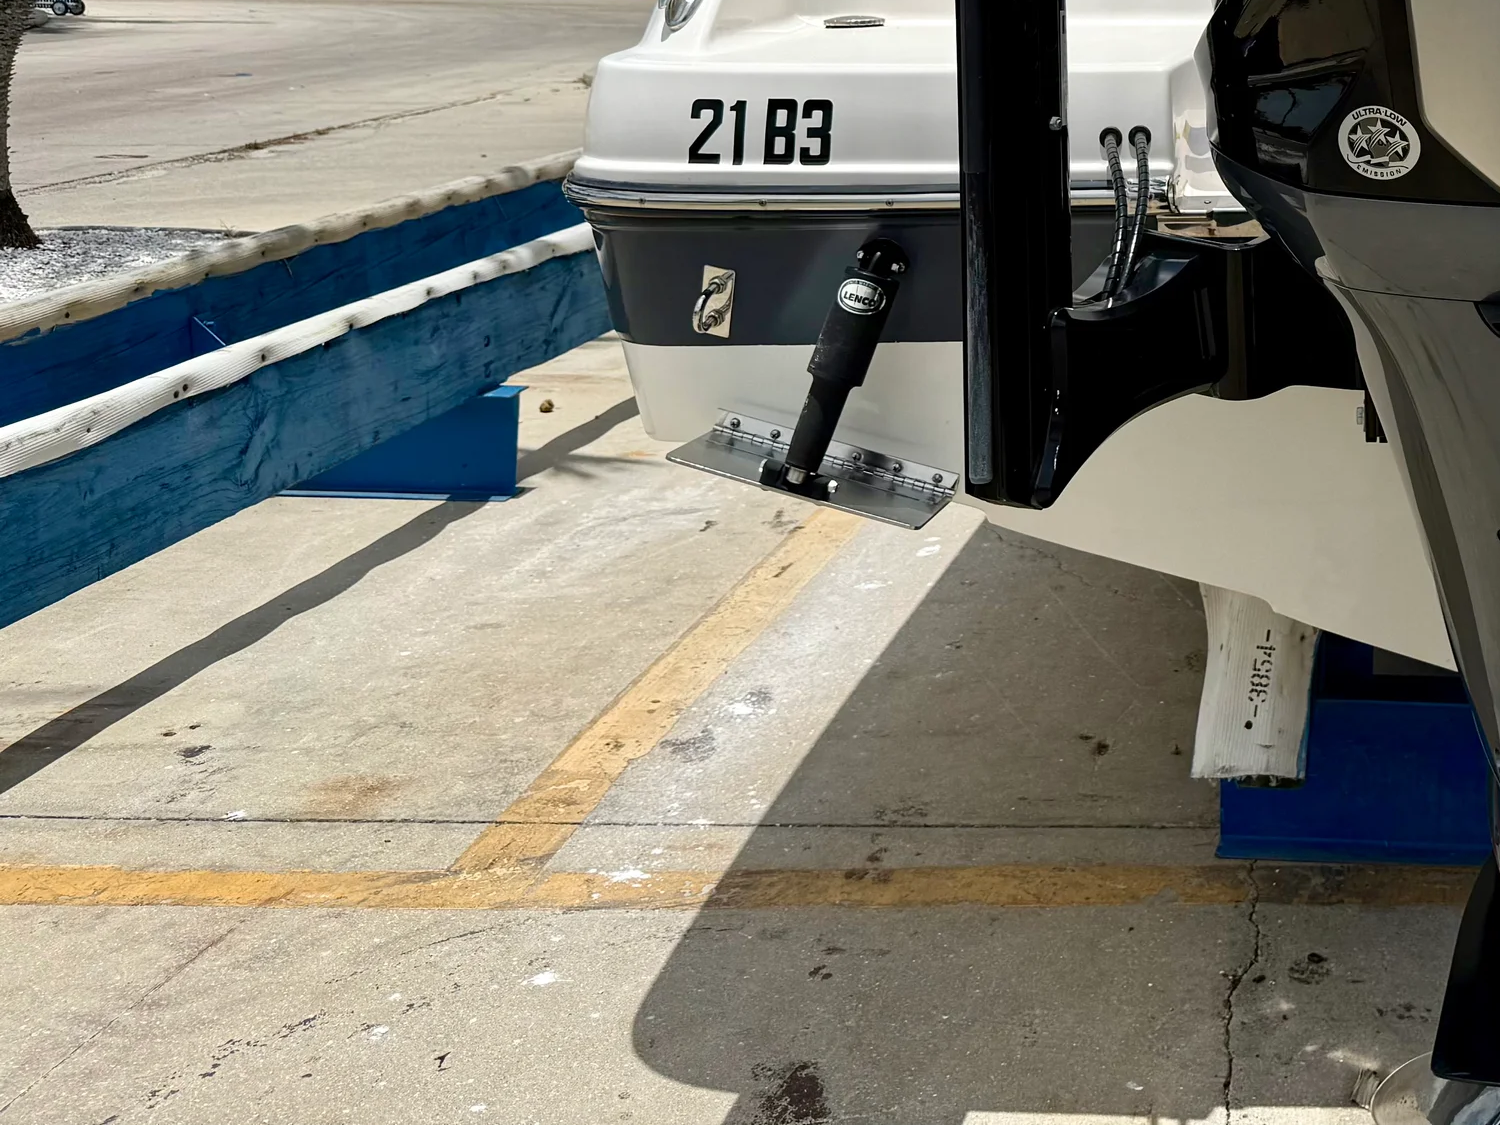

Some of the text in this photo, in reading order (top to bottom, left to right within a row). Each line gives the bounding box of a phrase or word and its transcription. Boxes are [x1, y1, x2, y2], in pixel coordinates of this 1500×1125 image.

[688, 98, 834, 166] 21 B3
[1356, 164, 1402, 177] EMISSION
[843, 291, 876, 307] LENCO
